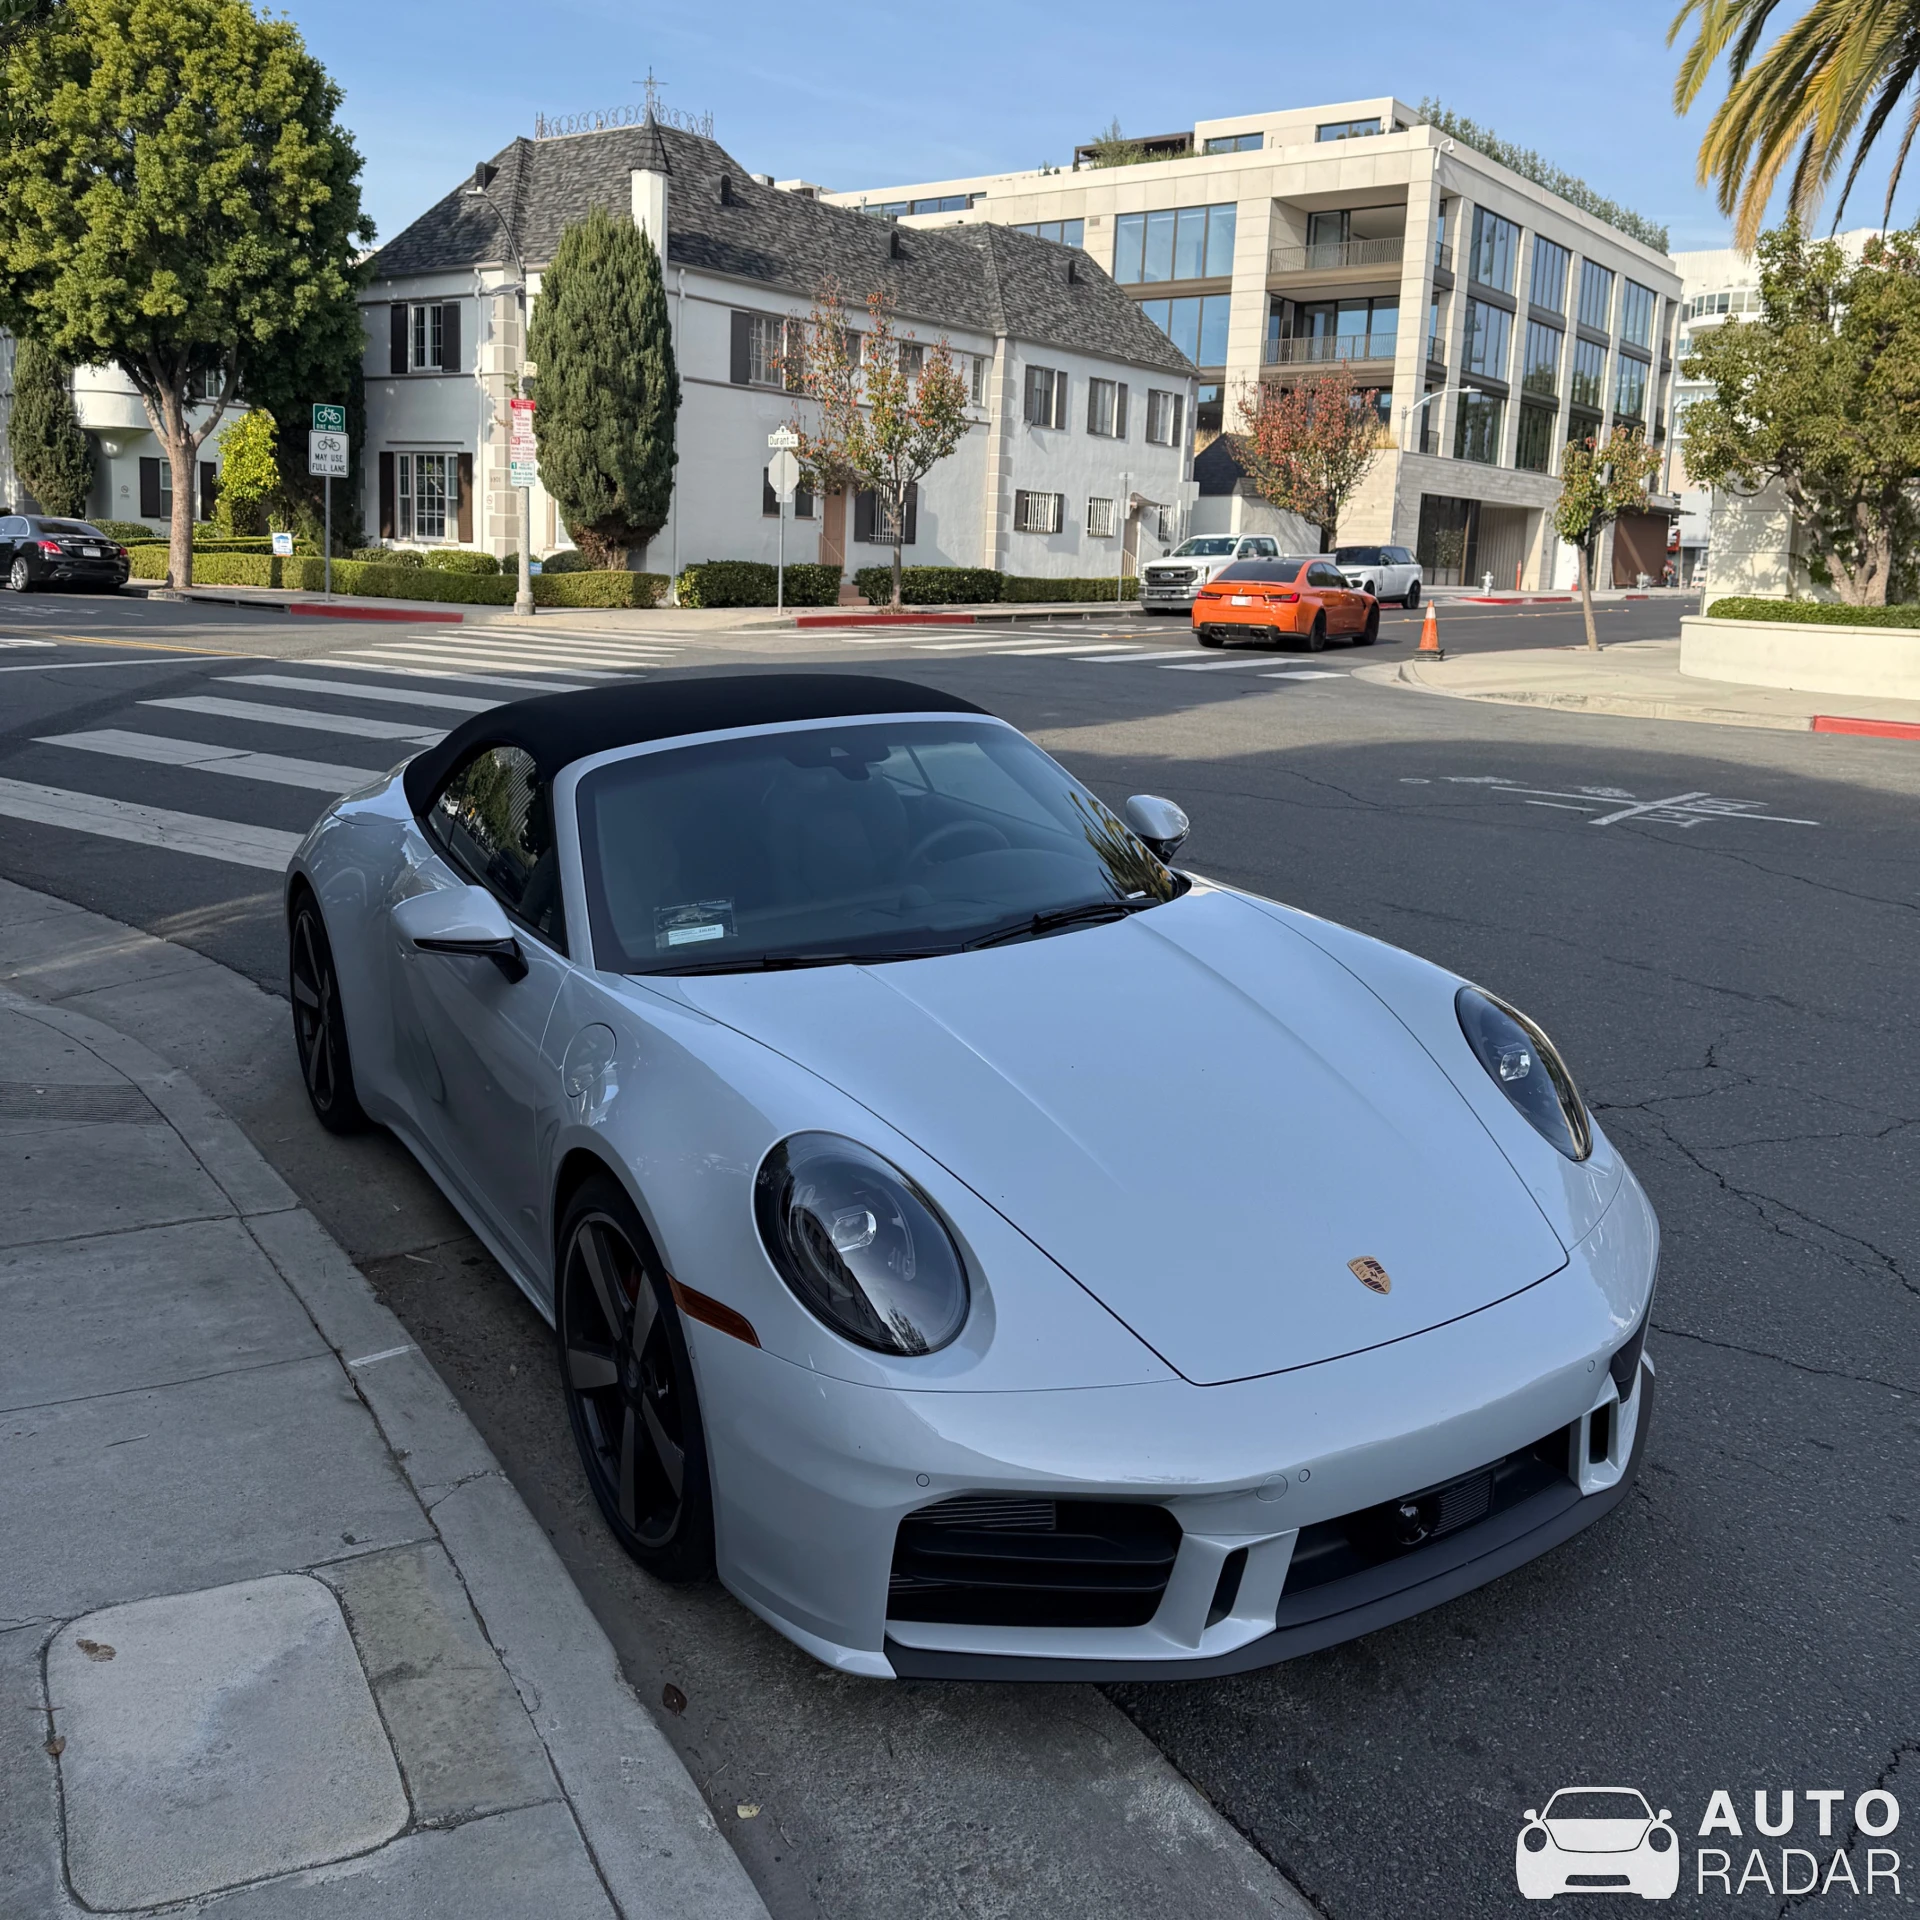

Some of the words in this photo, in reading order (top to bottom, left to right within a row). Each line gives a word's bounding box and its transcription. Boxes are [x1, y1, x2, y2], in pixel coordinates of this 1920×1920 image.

[769, 436, 789, 445] Durant
[314, 453, 328, 462] MAY
[312, 463, 327, 471] FULL
[330, 465, 346, 473] LANE
